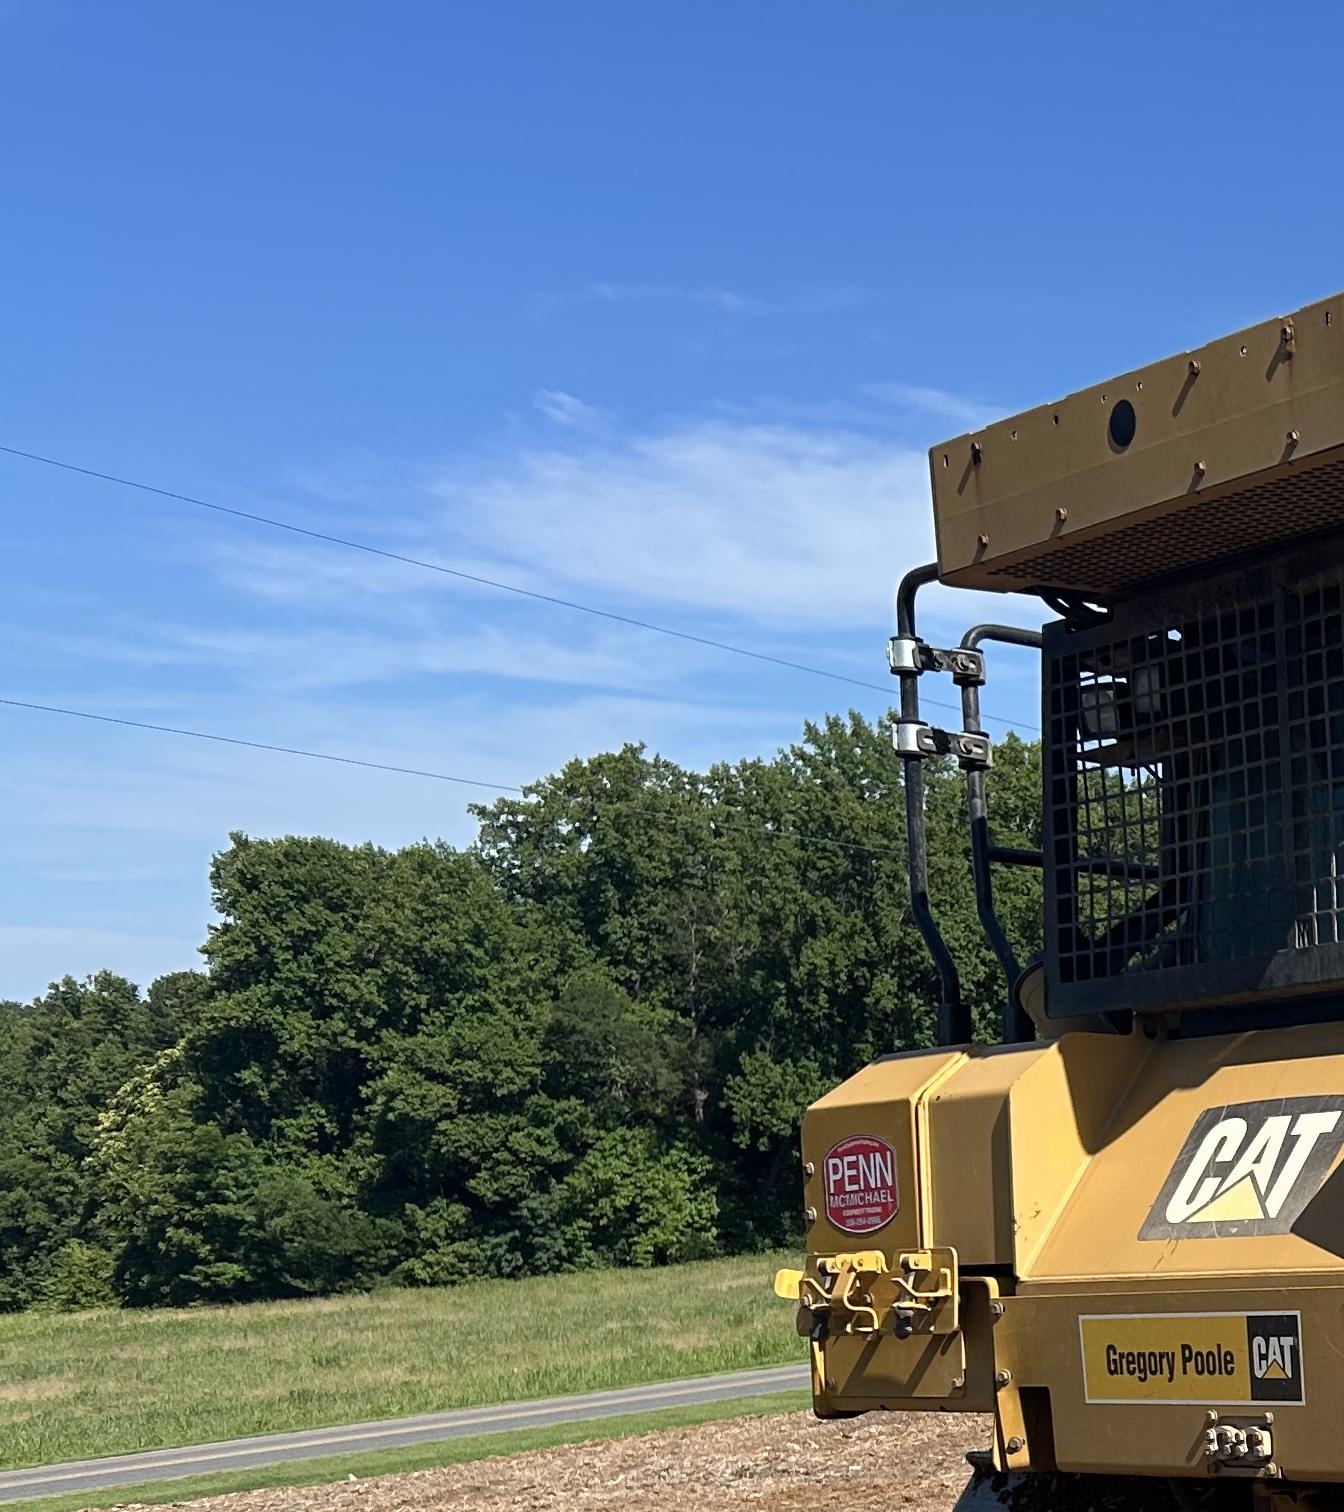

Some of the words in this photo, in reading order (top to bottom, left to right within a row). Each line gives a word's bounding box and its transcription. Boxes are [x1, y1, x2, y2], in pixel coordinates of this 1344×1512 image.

[828, 1151, 894, 1194] PENN
[1165, 1110, 1343, 1224] CAT
[829, 1189, 895, 1208] MCMICHAEL
[1105, 1343, 1176, 1383] Gregory
[1180, 1343, 1236, 1376] Poole
[1252, 1335, 1294, 1379] CAT
